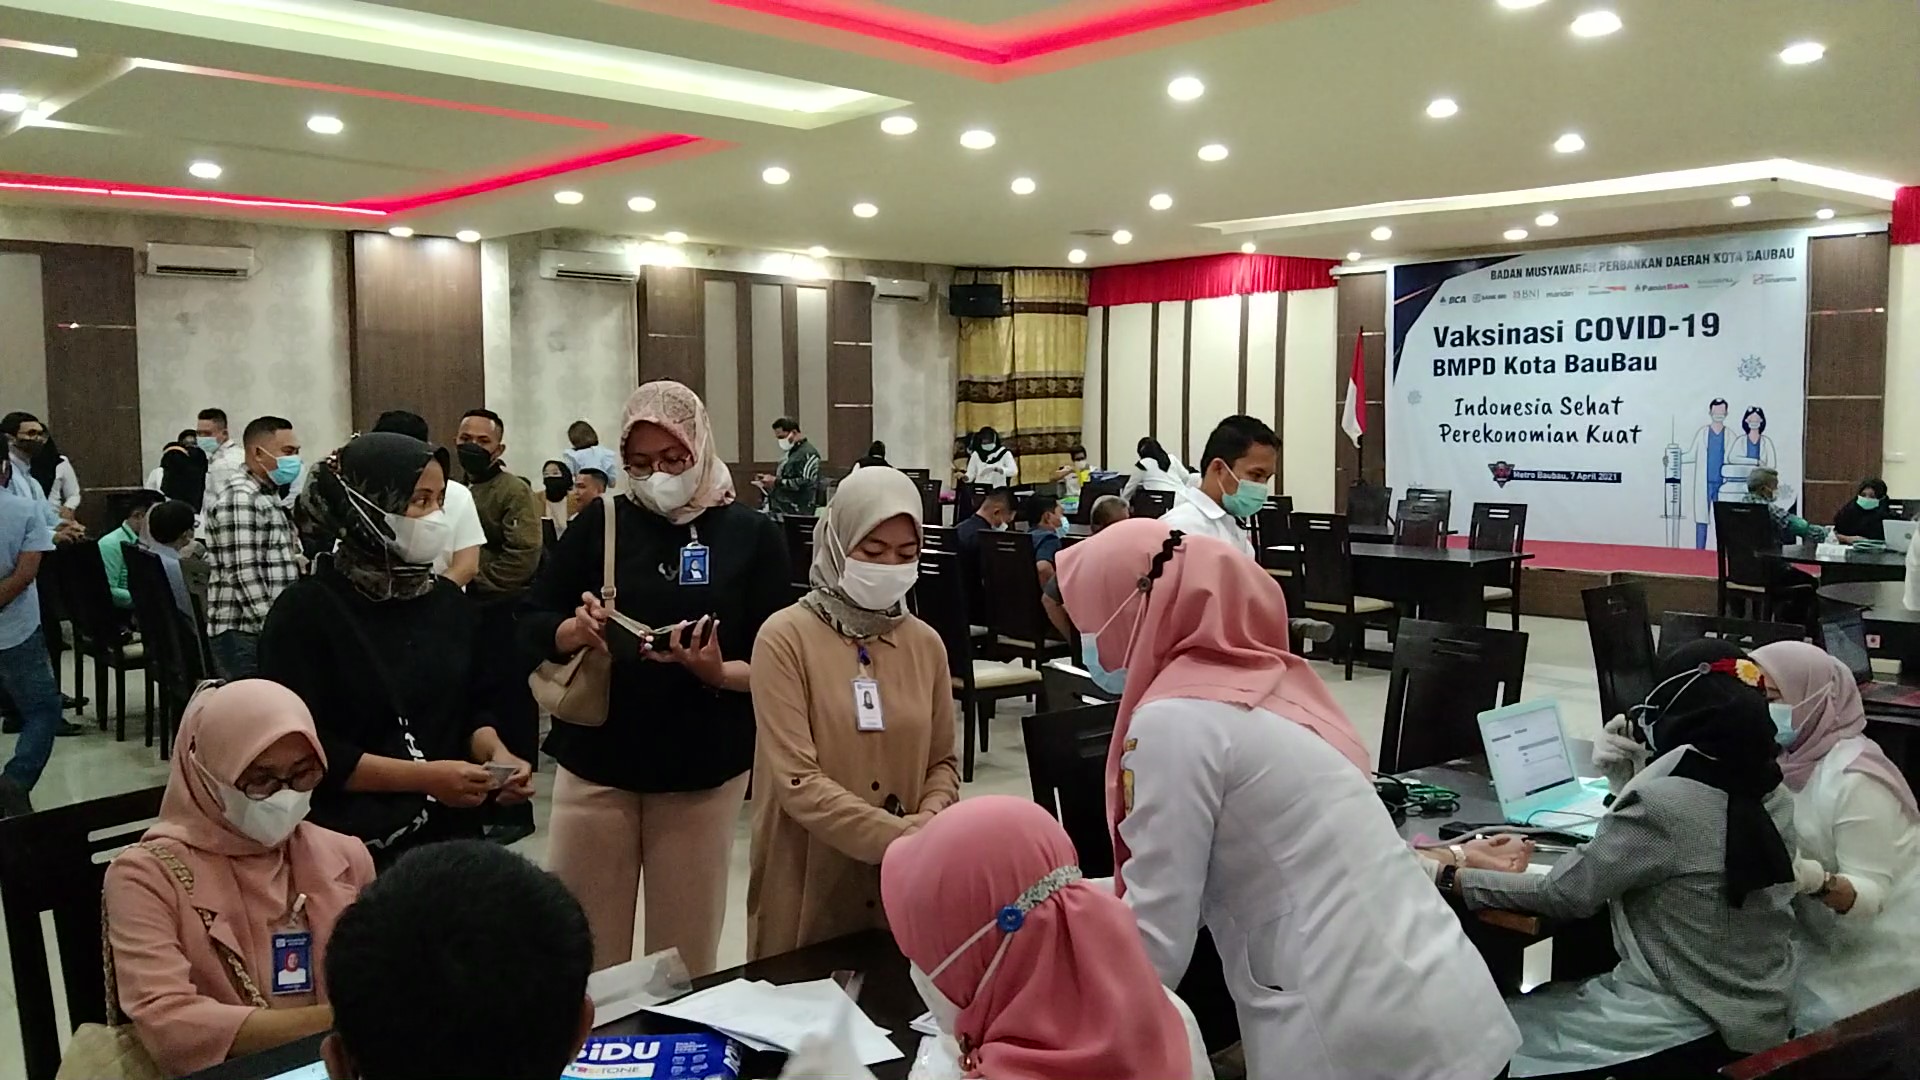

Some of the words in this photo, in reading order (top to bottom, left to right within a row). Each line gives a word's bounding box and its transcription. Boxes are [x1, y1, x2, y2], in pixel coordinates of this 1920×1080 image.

[1490, 268, 1523, 280] BADAN
[1598, 257, 1663, 273] PERBANKAN
[1665, 254, 1710, 268] DAERAH
[1713, 251, 1743, 264] KOTA
[1745, 247, 1795, 262] BAUBAU
[1432, 320, 1564, 348] Vaksinasi
[1574, 312, 1721, 343] COVID-19
[1432, 357, 1496, 377] BMPD
[1504, 356, 1556, 375] Kota
[1564, 352, 1658, 373] BauBau
[1454, 396, 1553, 416] Indonesia
[1559, 394, 1624, 416] Sehat
[1438, 422, 1579, 443] Perekonomian
[1586, 424, 1643, 444] Kuat
[1512, 470, 1536, 479] Metro
[1570, 471, 1575, 480] 7
[1576, 471, 1597, 481] April
[1597, 472, 1618, 481] 2021
